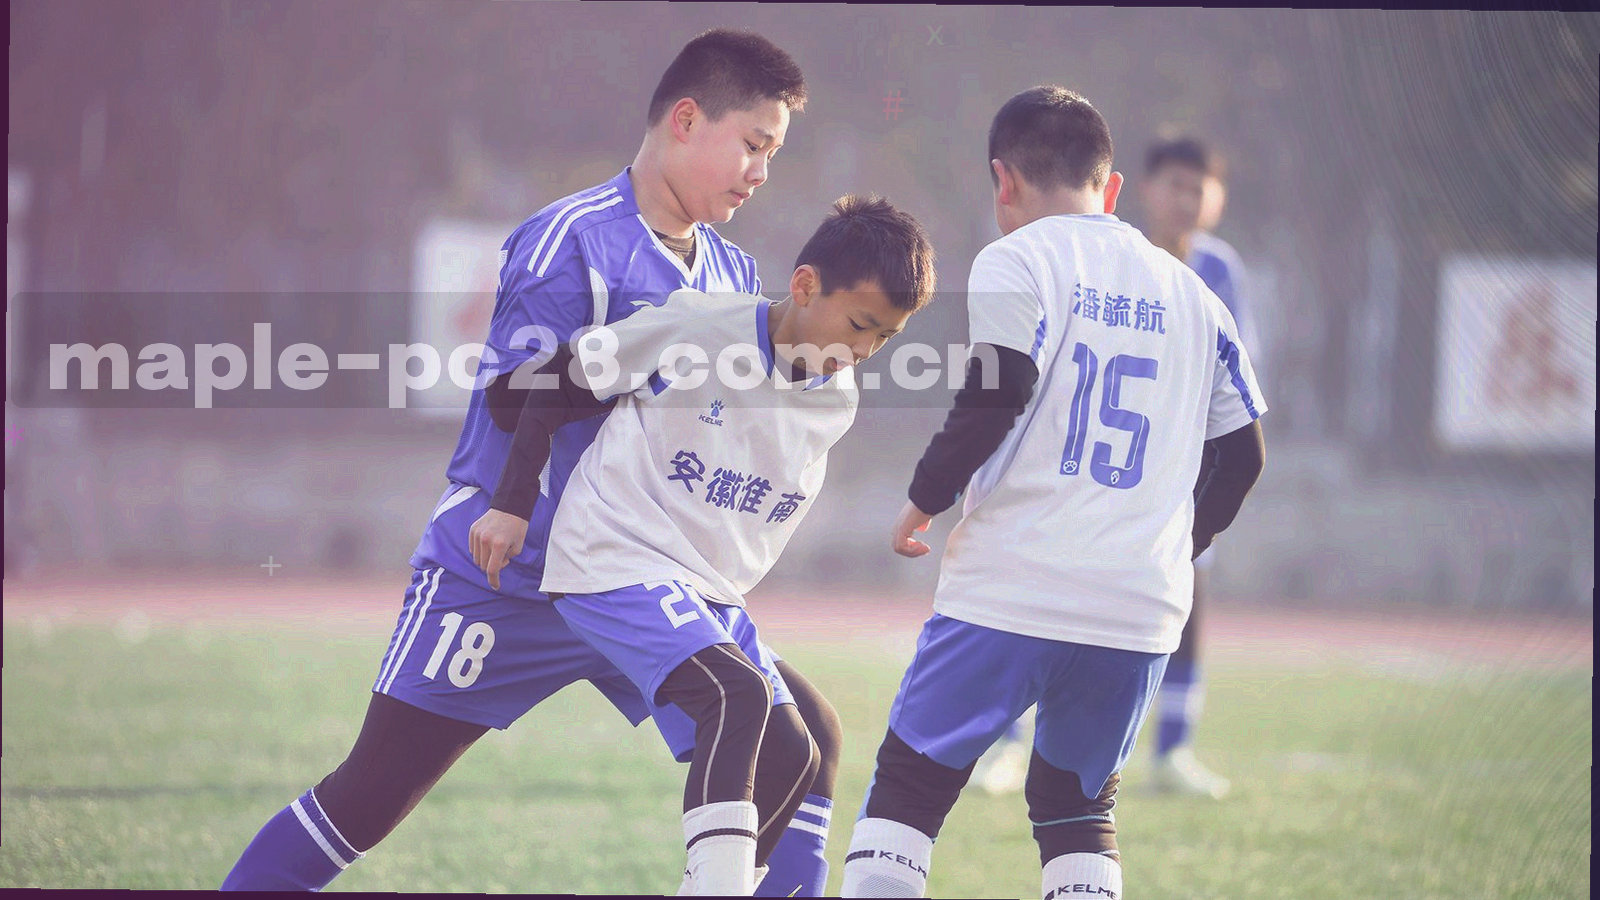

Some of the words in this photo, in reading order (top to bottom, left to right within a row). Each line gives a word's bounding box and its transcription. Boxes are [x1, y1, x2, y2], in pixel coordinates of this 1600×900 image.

[1072, 283, 1166, 335] 潘毓航
[1059, 342, 1159, 489] 15
[667, 450, 807, 524] 安徽淮南
[422, 611, 496, 689] 18
[1057, 883, 1118, 899] KELME
